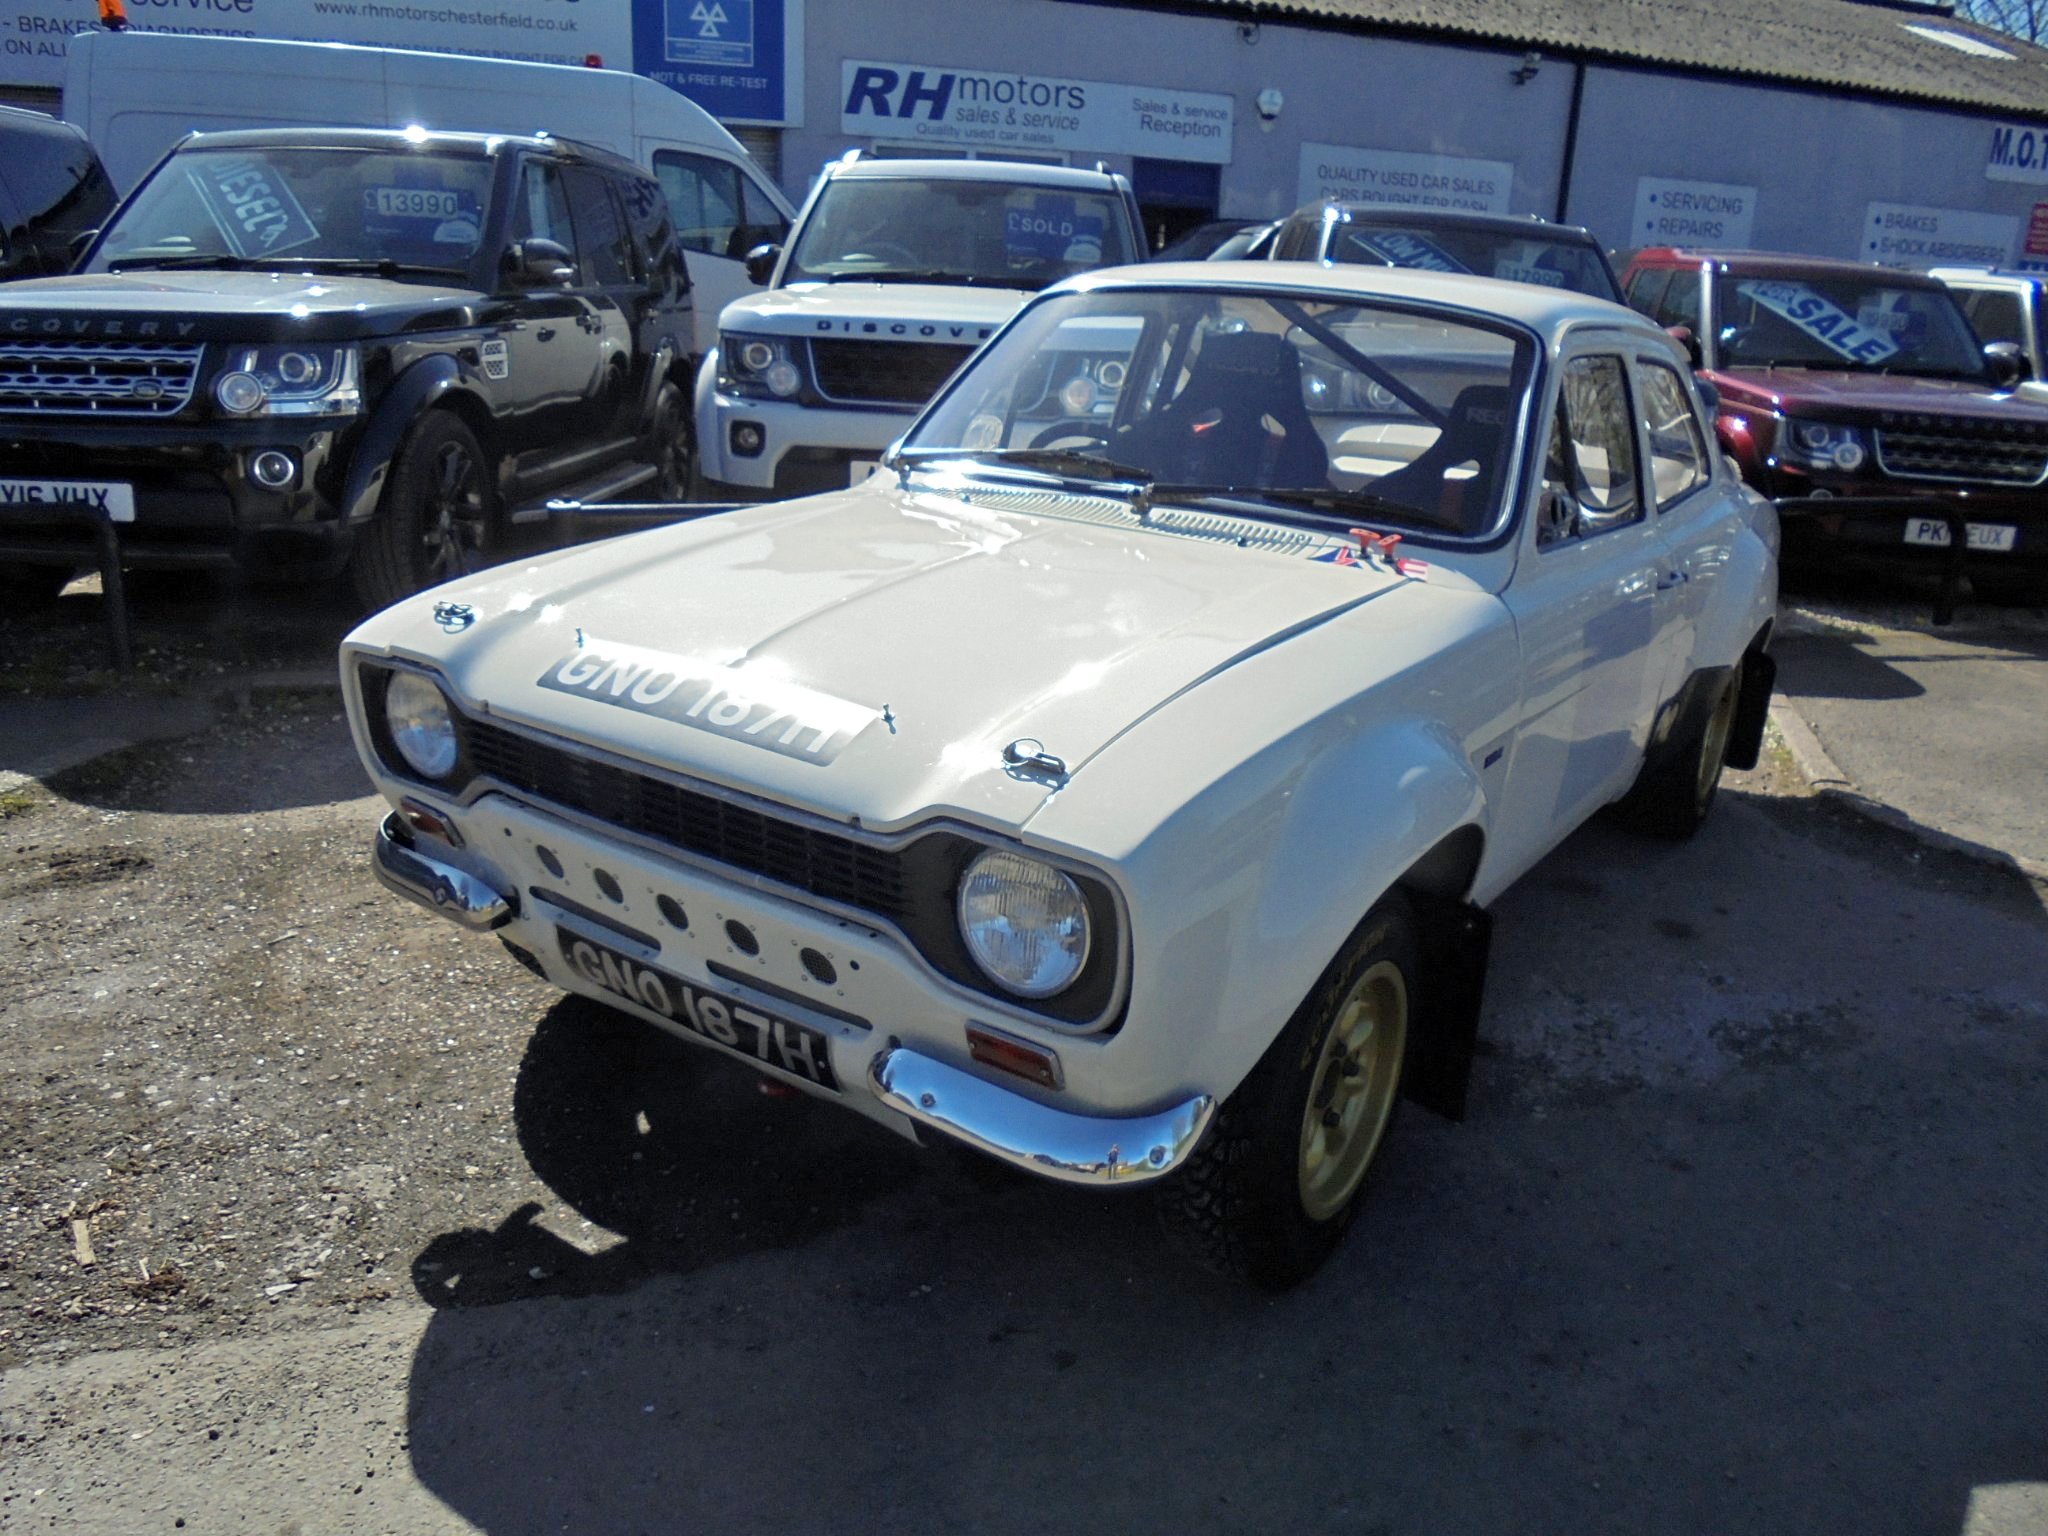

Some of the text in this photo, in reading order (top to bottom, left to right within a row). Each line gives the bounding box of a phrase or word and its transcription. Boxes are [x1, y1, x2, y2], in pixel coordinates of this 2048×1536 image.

[19, 16, 101, 35] BRAKES
[314, 2, 578, 32] www.rhmotorschesterfield.co.uk
[6, 39, 33, 55] ON
[688, 73, 717, 86] FREE
[956, 106, 1080, 131] sales & service
[1132, 98, 1228, 121] Sales & service
[916, 122, 1054, 144] Quality used car sales
[1140, 115, 1221, 139] Reception
[1318, 164, 1495, 195] QUALITY USED CAR SALES
[1662, 192, 1743, 214] SERVICING
[1658, 218, 1723, 239] REPAIRS
[1885, 213, 1938, 233] BRAKES
[1881, 237, 1925, 257] SHOCK
[1787, 298, 1891, 363] SALE
[572, 941, 820, 1082] GNO 187H
